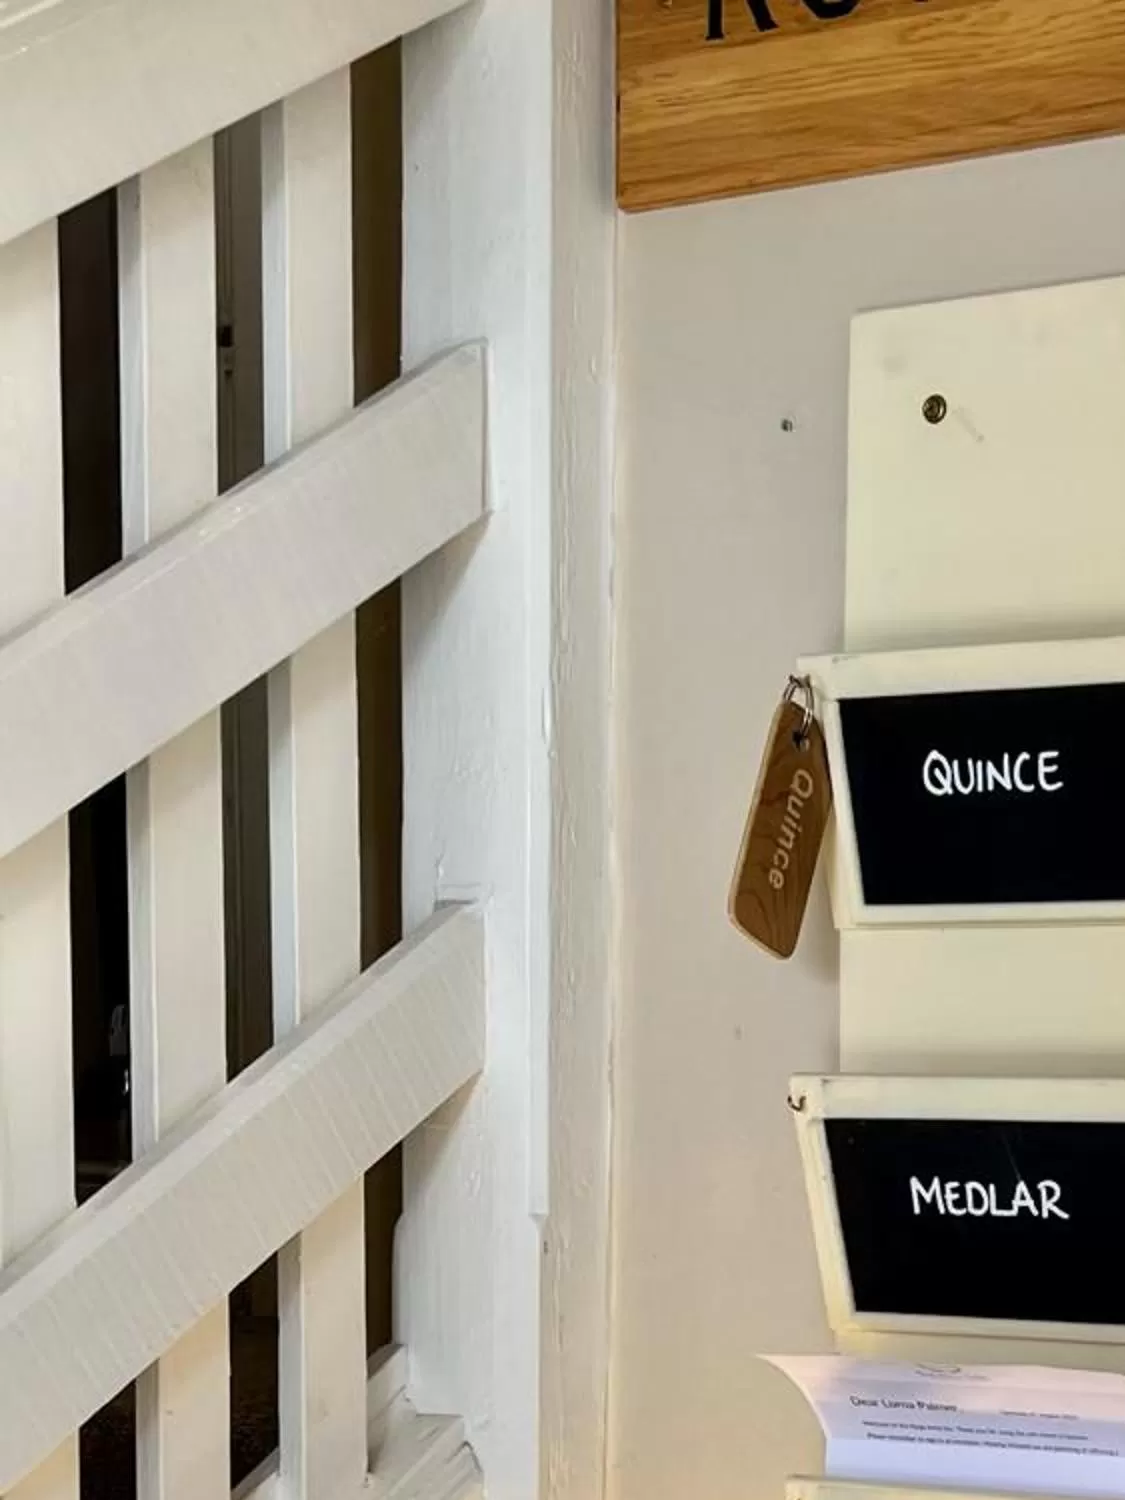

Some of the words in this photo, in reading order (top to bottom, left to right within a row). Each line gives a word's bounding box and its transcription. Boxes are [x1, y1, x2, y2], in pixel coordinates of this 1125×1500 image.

[923, 750, 1063, 795] QUINCE
[768, 767, 814, 890] Quince
[909, 1175, 1070, 1220] MEDLAR
